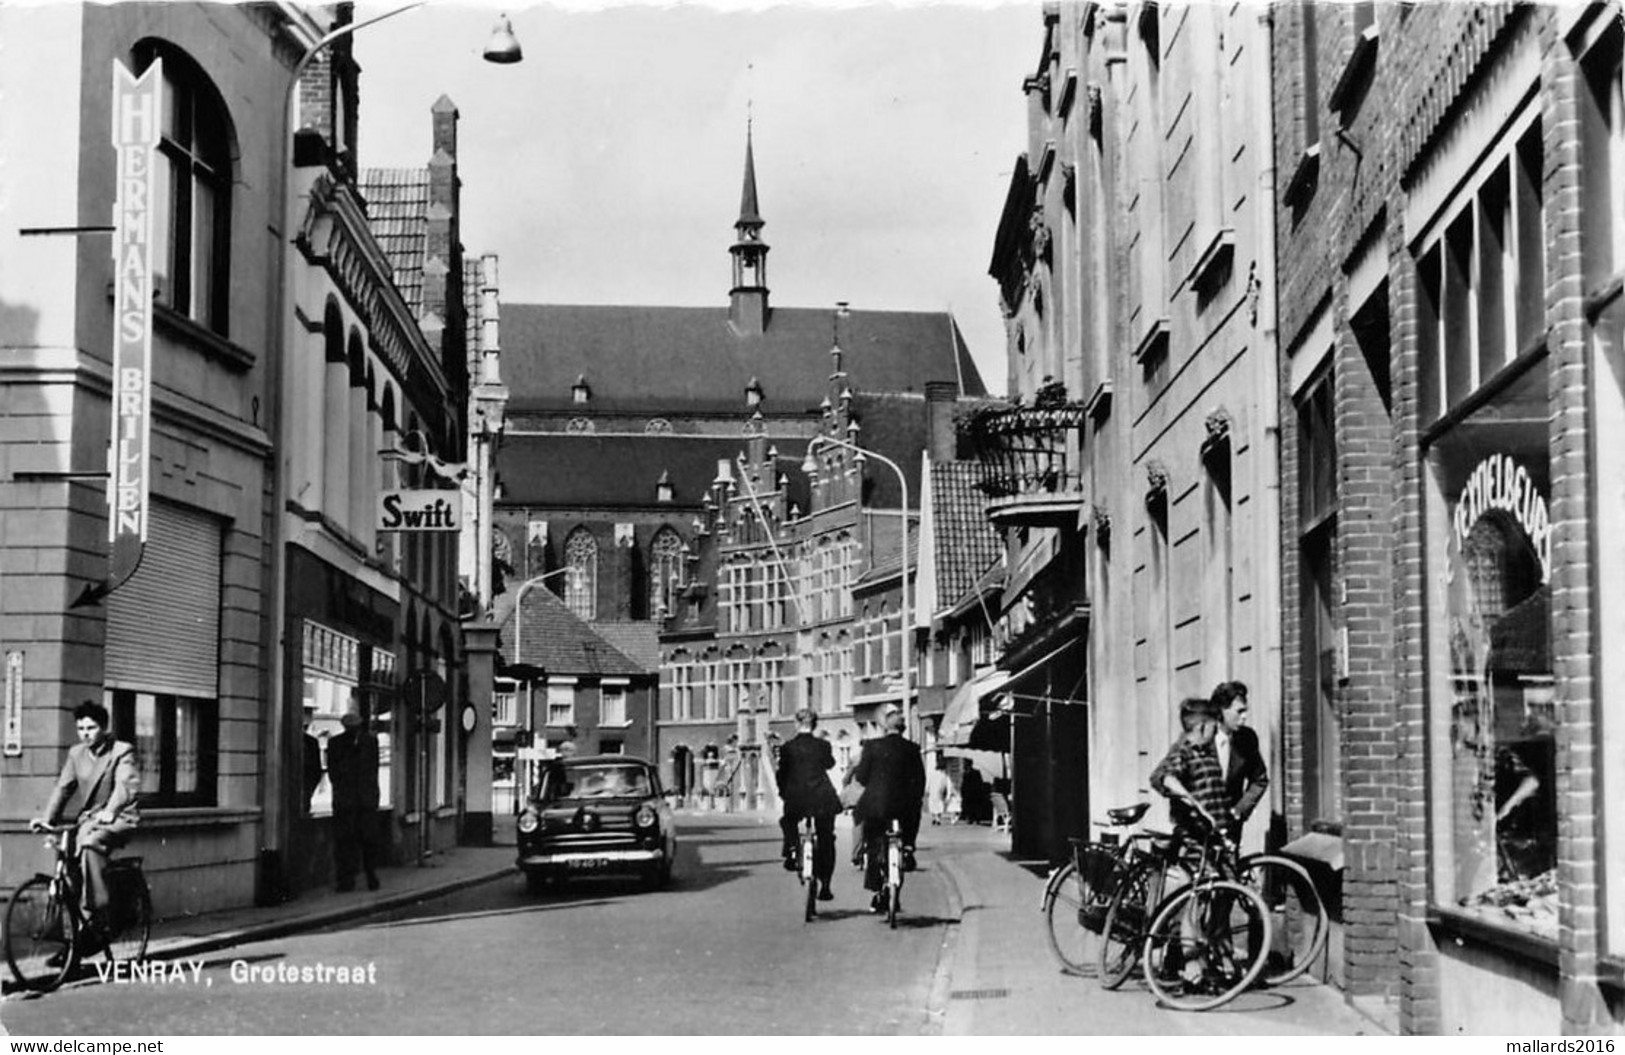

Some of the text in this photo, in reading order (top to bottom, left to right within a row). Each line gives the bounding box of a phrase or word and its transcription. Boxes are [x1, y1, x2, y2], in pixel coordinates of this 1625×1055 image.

[117, 93, 152, 535] HERMANS BRILLEN
[382, 494, 456, 528] Swift
